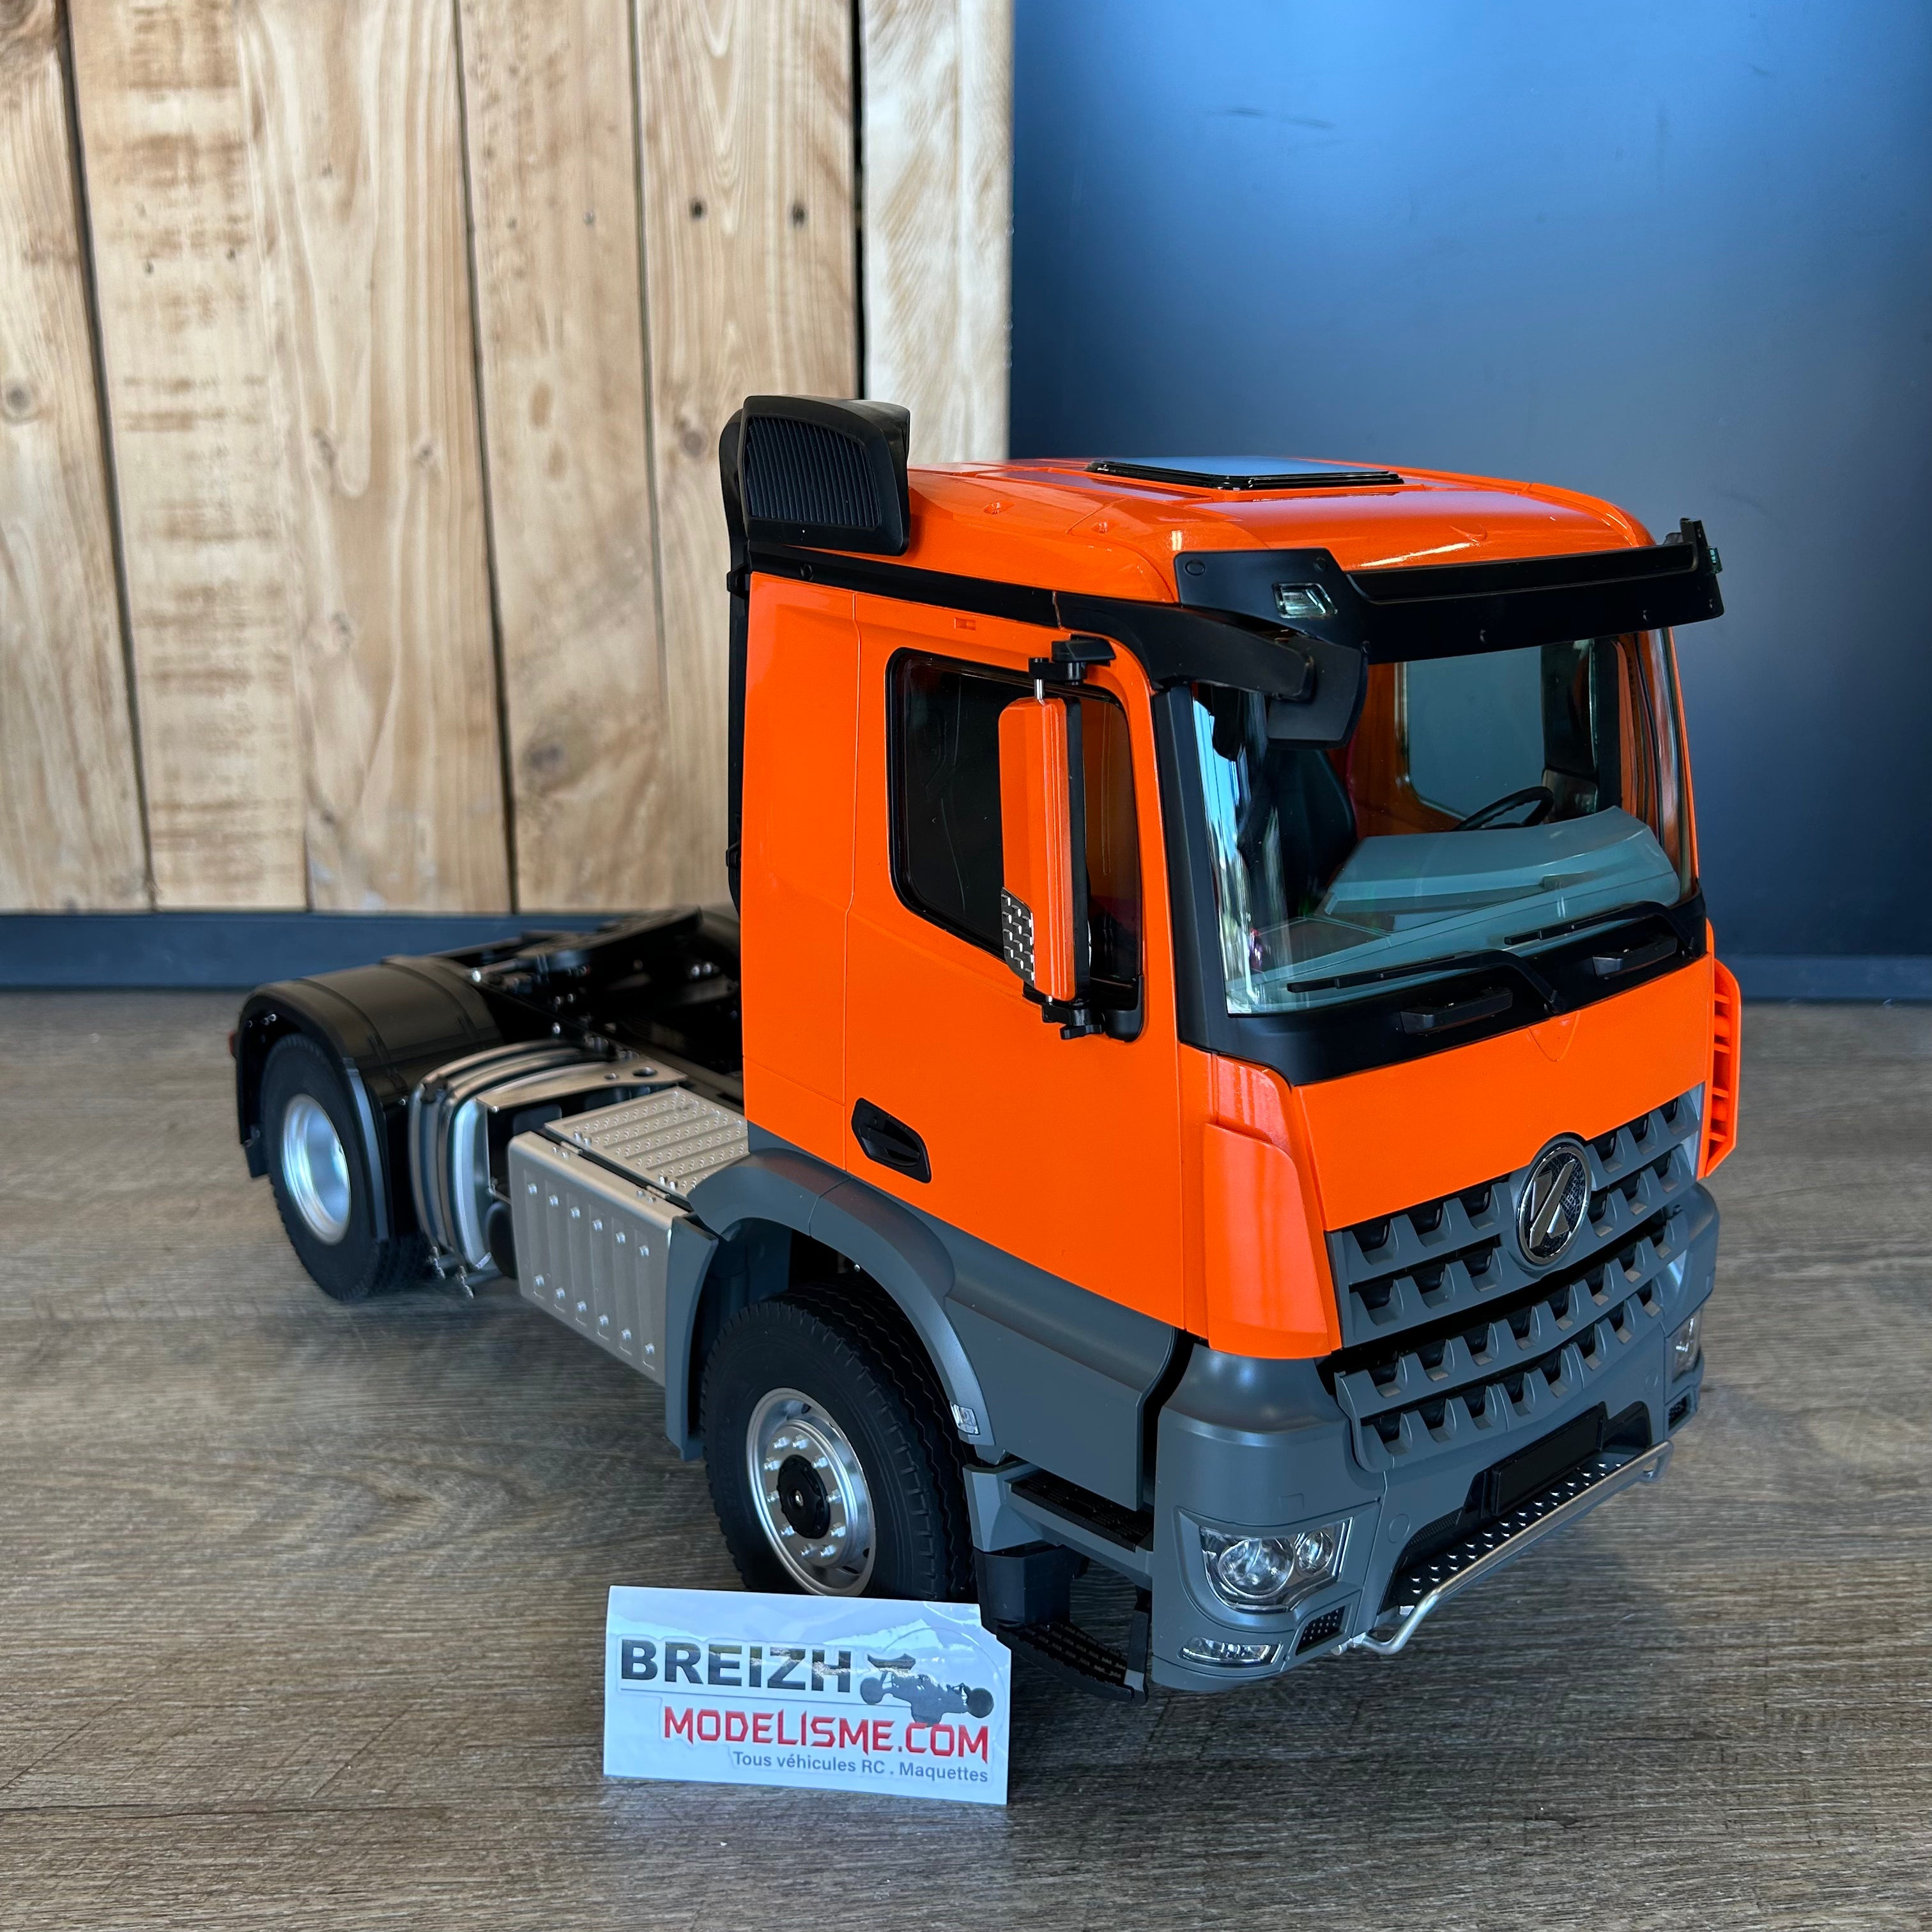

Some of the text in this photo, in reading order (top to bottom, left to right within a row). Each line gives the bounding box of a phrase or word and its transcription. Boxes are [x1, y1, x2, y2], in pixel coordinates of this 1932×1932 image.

[621, 1639, 851, 1693] BREIZH
[664, 1706, 988, 1765] MODELISME.COM
[733, 1751, 772, 1767] Tous
[776, 1753, 856, 1772] véhicules
[862, 1759, 885, 1774] RC
[899, 1761, 988, 1782] Maquettes
